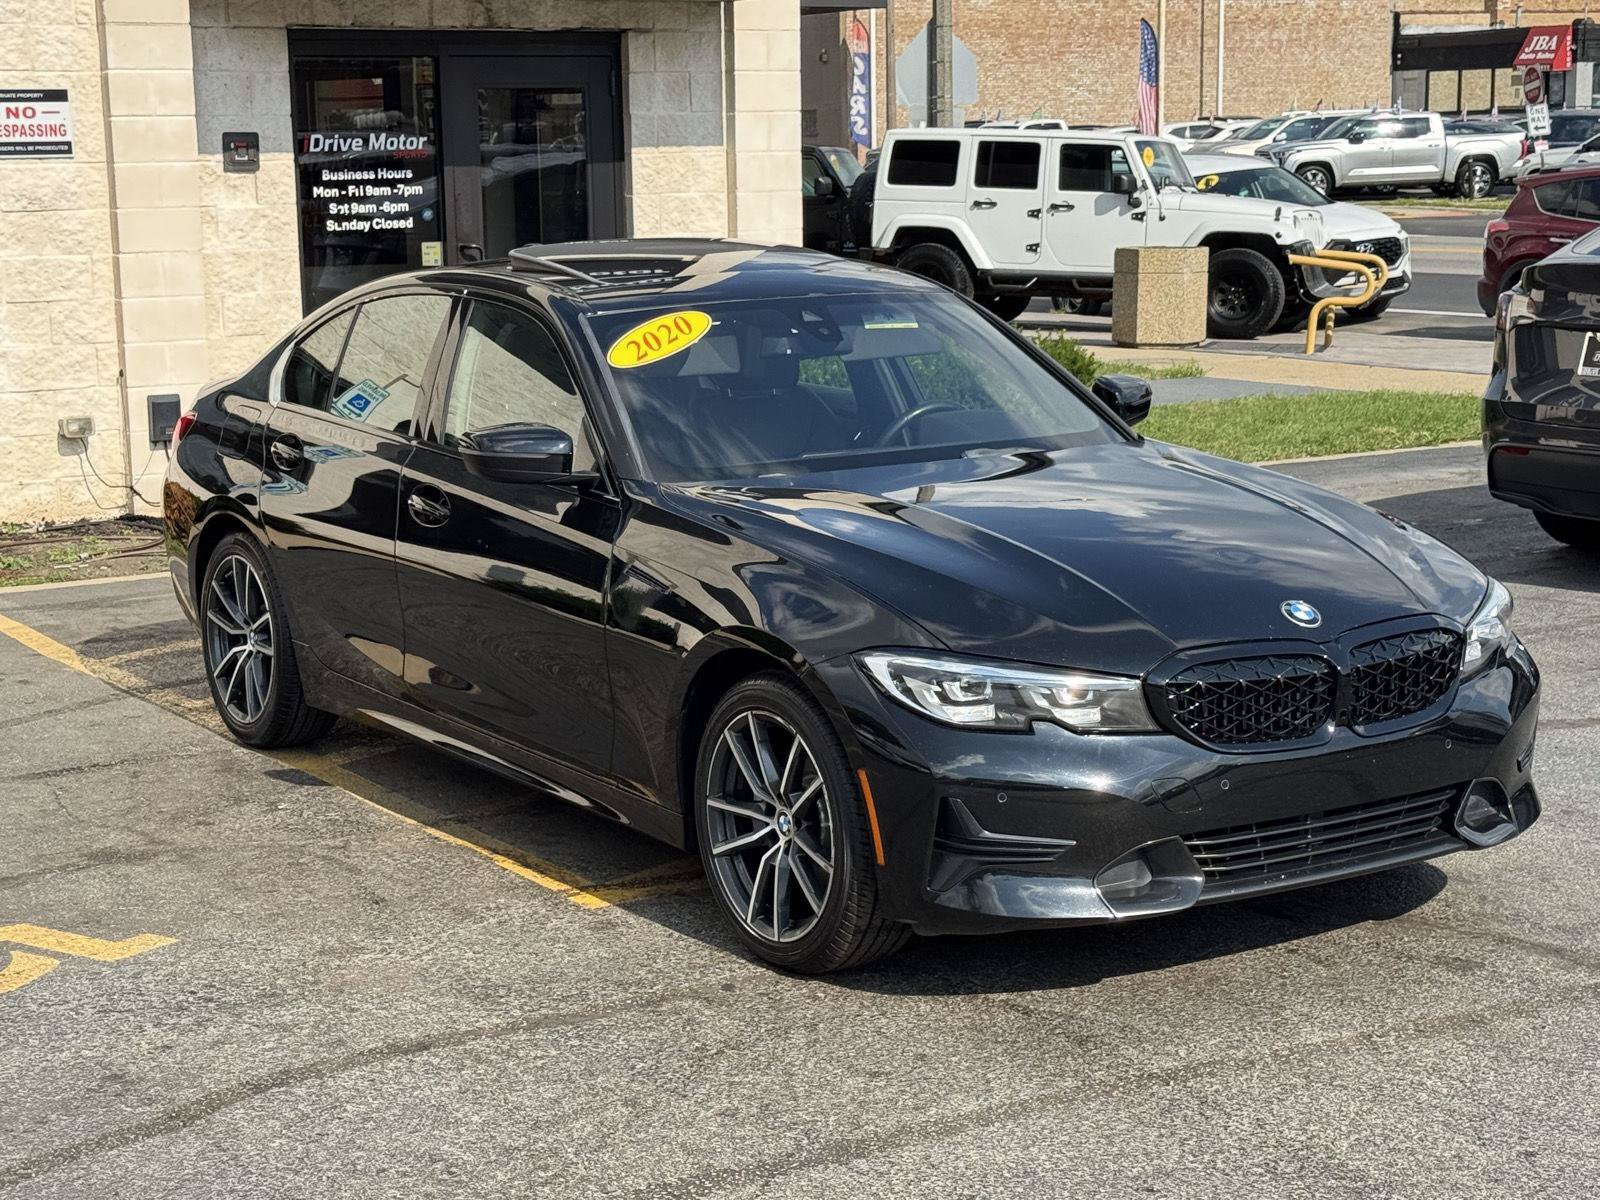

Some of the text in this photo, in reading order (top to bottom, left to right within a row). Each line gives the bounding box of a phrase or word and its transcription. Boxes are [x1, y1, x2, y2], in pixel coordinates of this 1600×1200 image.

[1524, 35, 1559, 53] JBA
[5, 106, 37, 119] NO
[1529, 107, 1545, 116] ONE
[1530, 116, 1546, 124] WAY
[303, 132, 428, 154] iDrive Motor
[321, 168, 413, 180] Business Hours
[312, 186, 340, 198] Mon
[365, 186, 392, 197] 9am
[350, 202, 377, 214] 9am
[326, 216, 414, 232] Sunday Closed
[626, 315, 693, 361] 2020
